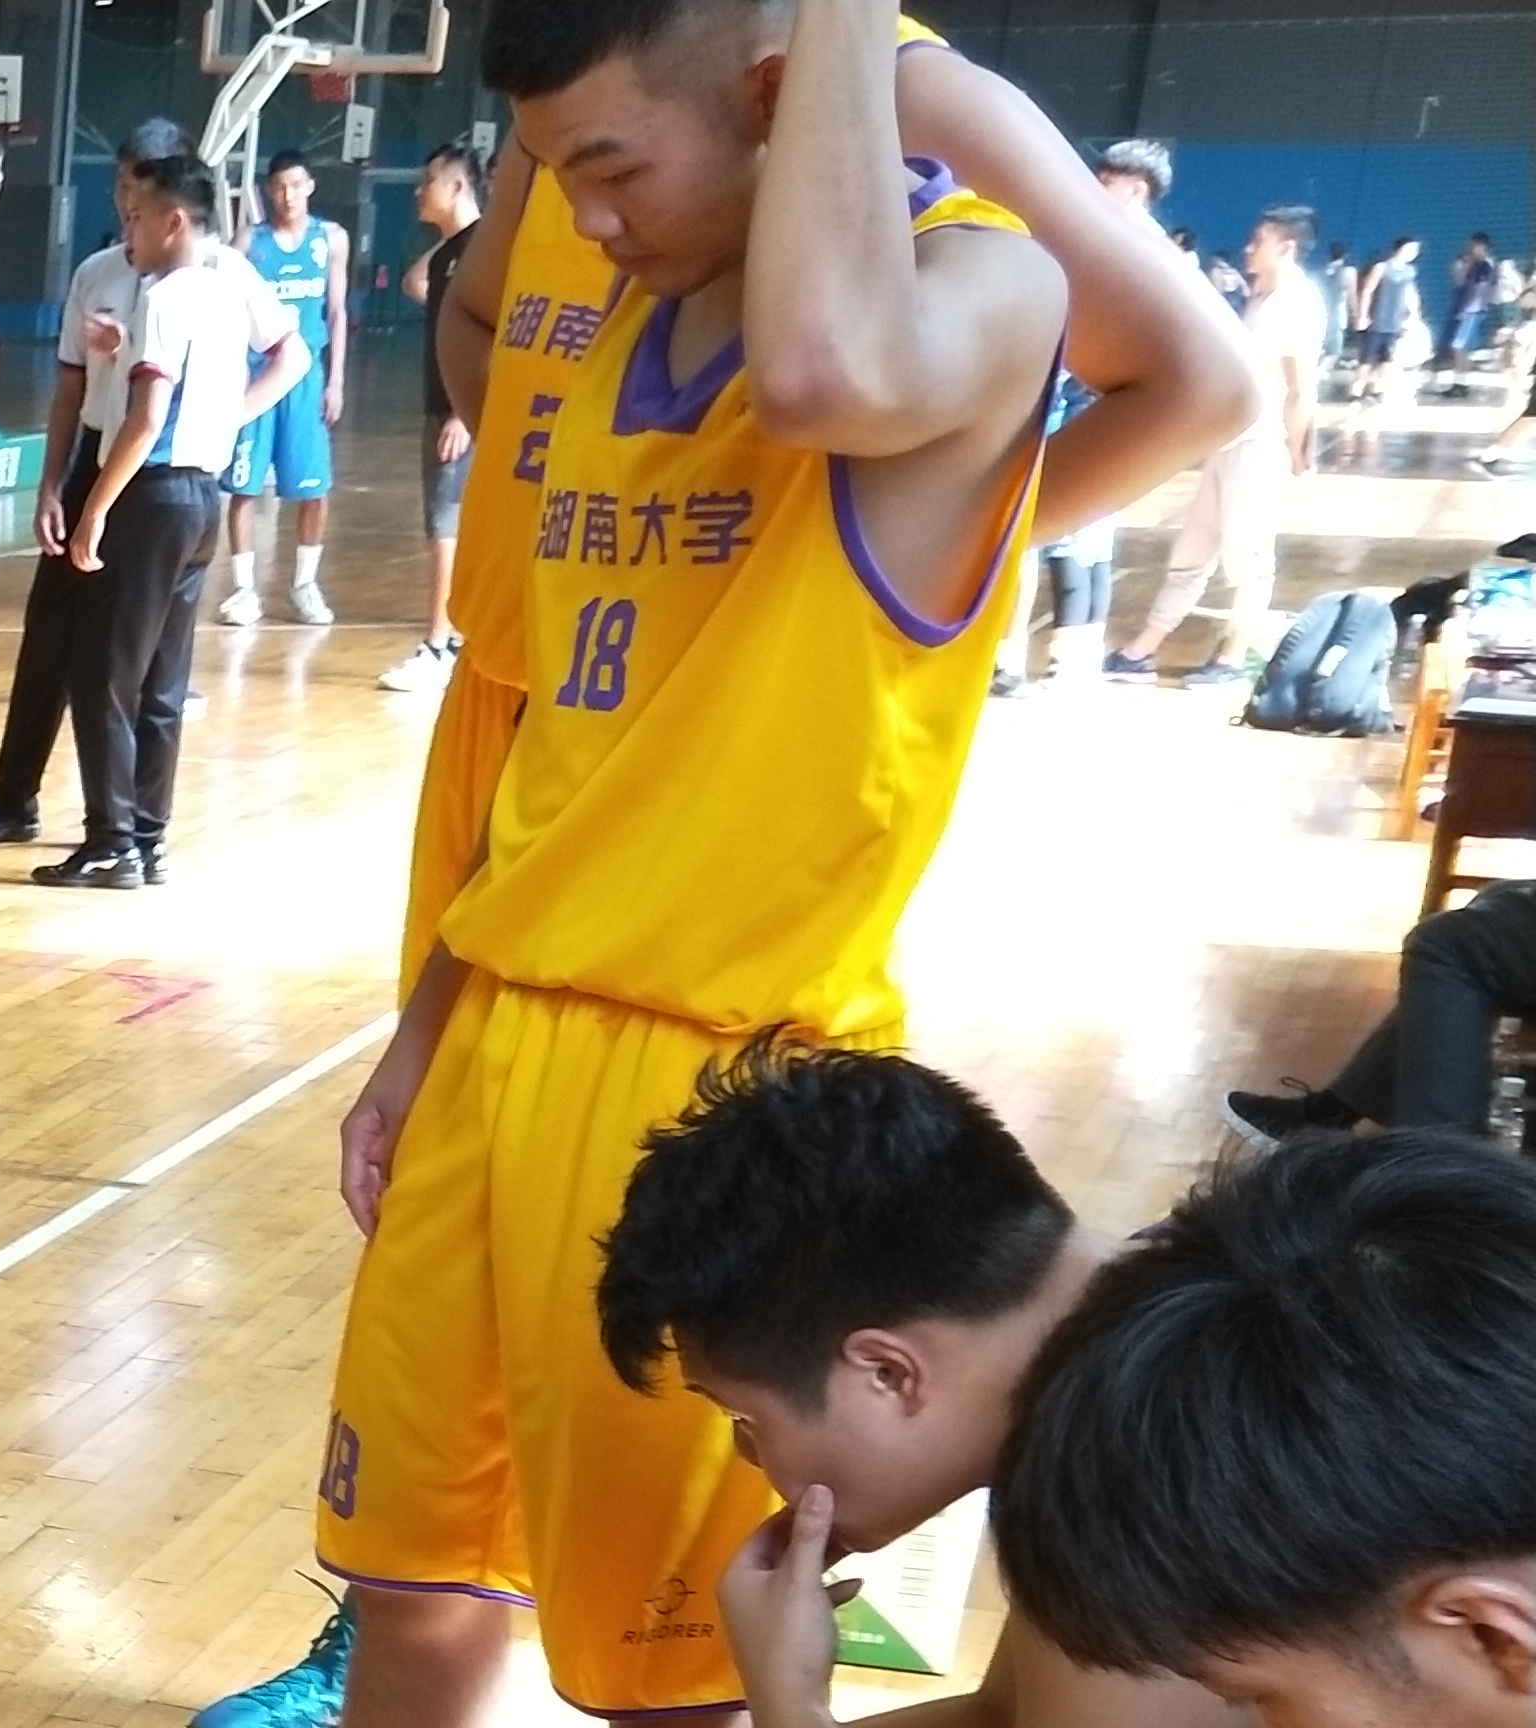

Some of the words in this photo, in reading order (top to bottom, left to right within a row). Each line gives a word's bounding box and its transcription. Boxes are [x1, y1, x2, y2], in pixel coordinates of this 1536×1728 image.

[534, 489, 754, 567] 湖南大学
[555, 596, 637, 712] 18
